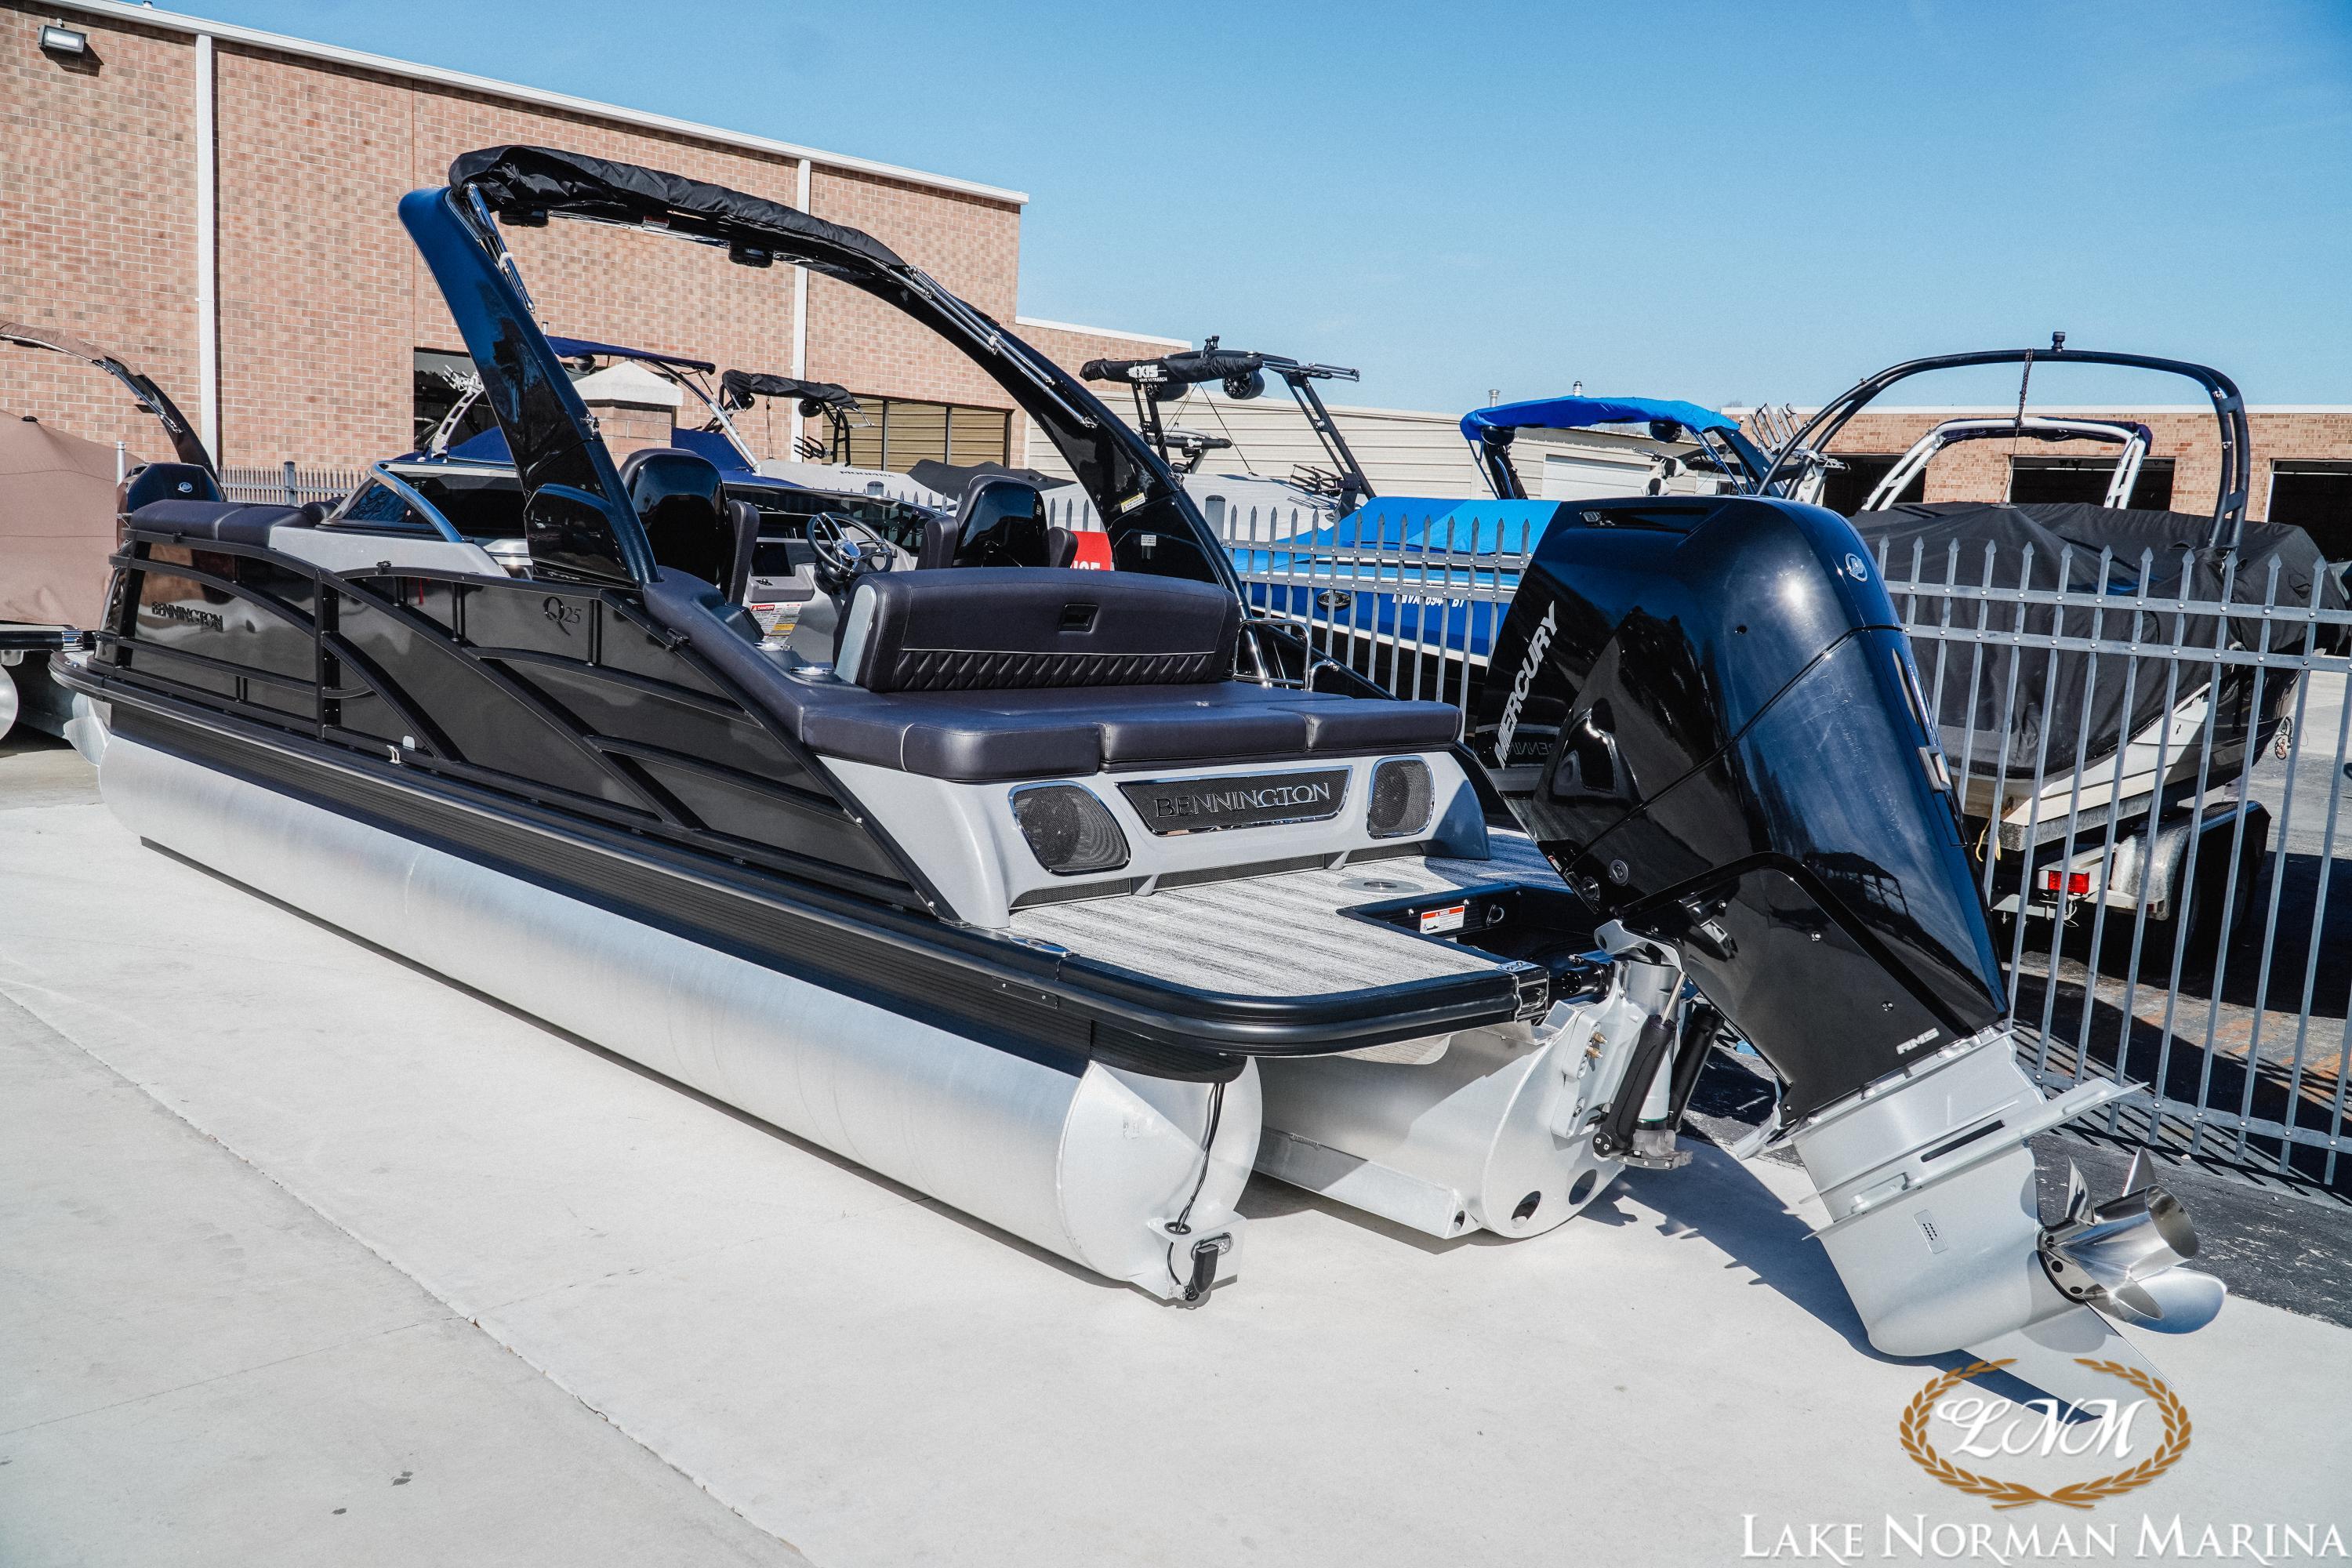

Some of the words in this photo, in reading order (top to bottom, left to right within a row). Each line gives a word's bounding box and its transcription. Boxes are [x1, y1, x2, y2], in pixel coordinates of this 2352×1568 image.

[1494, 600, 1558, 771] MERCURY
[1154, 782, 1330, 818] BENNINGTON
[1896, 1027, 1940, 1055] AMS
